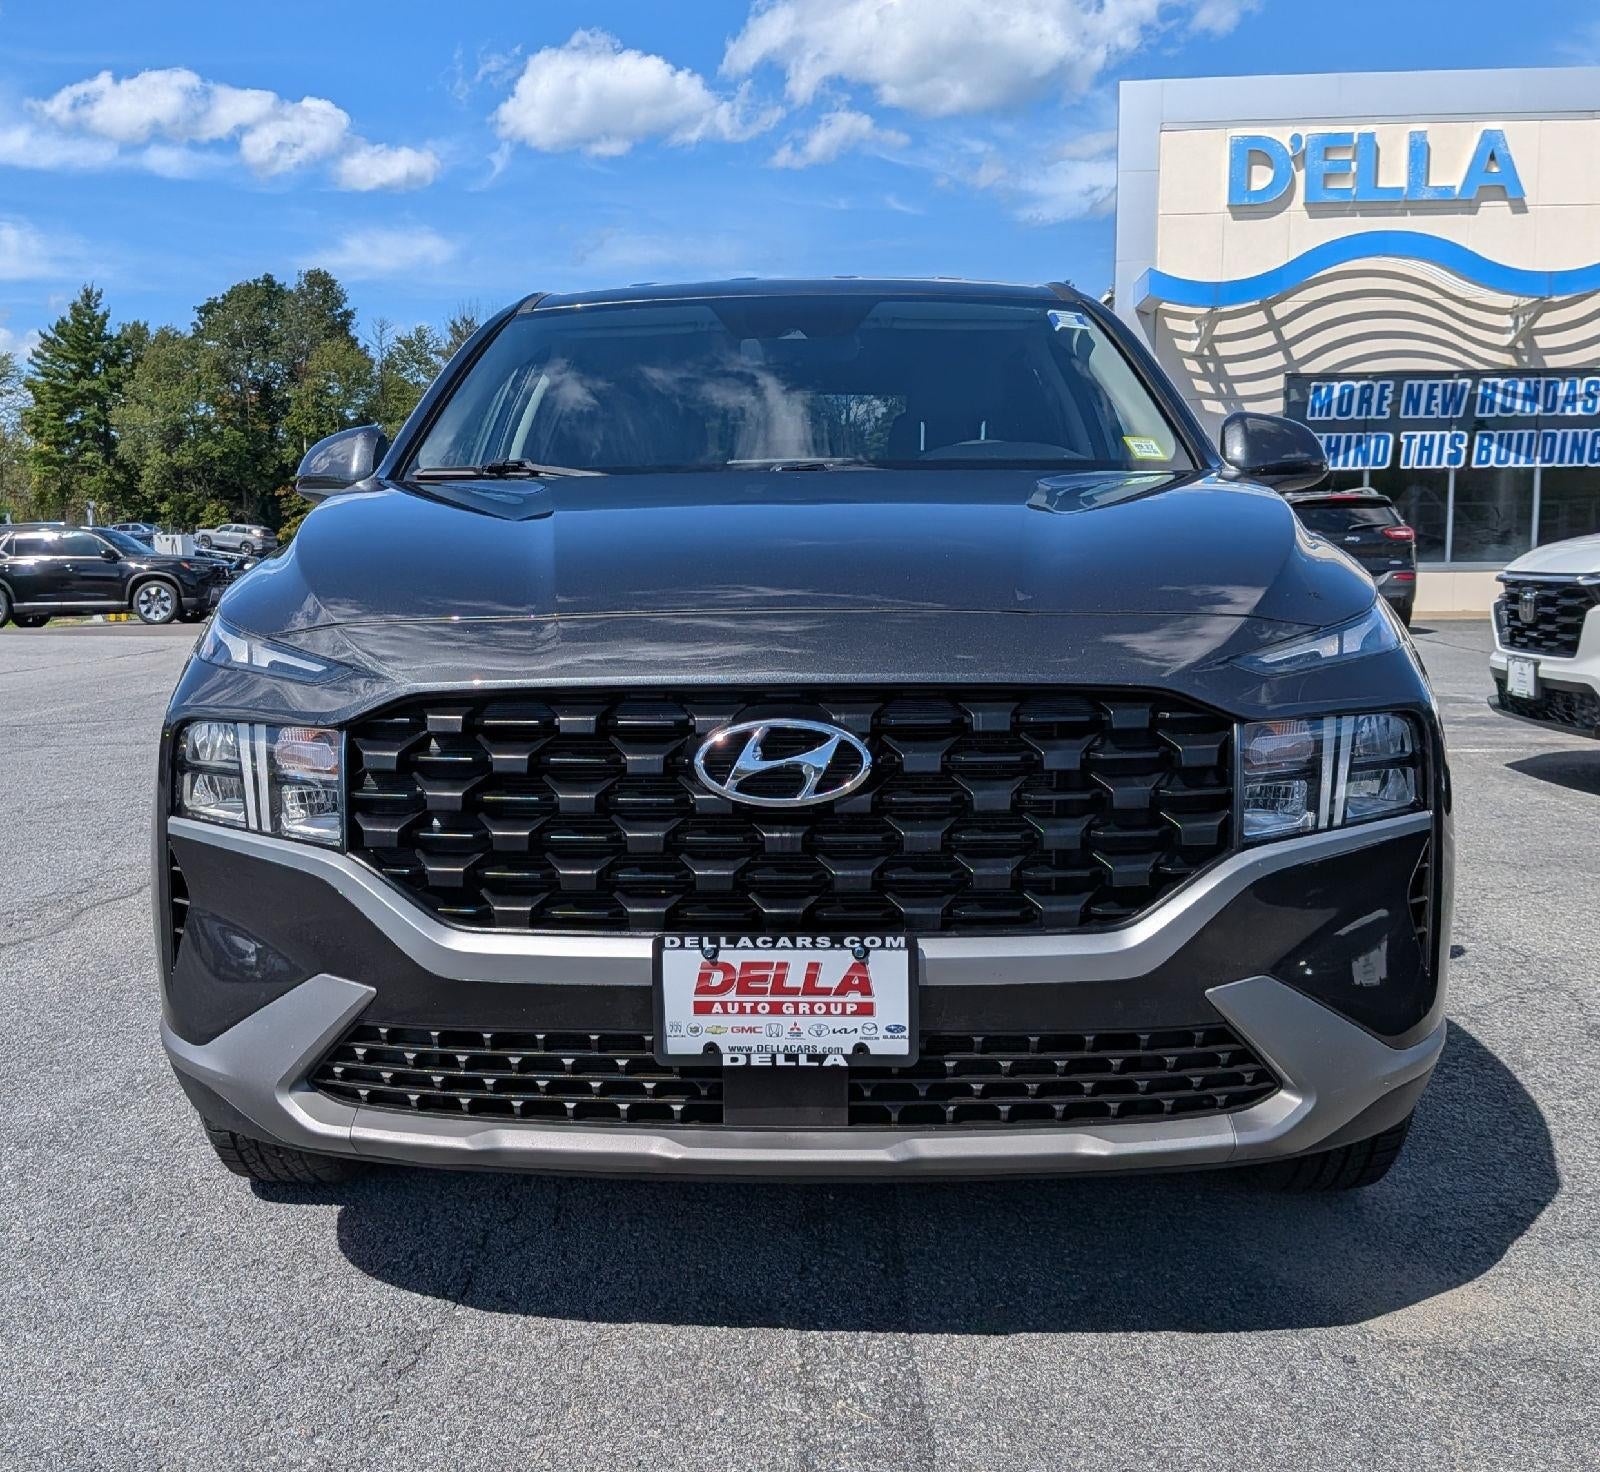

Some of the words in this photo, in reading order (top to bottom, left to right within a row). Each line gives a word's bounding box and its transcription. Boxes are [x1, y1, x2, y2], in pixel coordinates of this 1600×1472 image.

[1228, 130, 1526, 205] D'ELLA
[1307, 380, 1393, 420] MORE
[1400, 379, 1472, 418] NEW
[1475, 376, 1600, 416] HONDAS
[1316, 432, 1394, 470] HIND
[1400, 430, 1468, 469] THIS
[1471, 429, 1600, 468] BUILDING
[664, 936, 906, 949] DELLACARS.COM
[693, 961, 875, 998] DELLA
[711, 1002, 771, 1014] AUTO
[782, 1002, 858, 1014] GROUP
[730, 1026, 763, 1034] GMC
[728, 1044, 844, 1055] www.DELLACARS.com
[722, 1053, 849, 1067] DELLA
